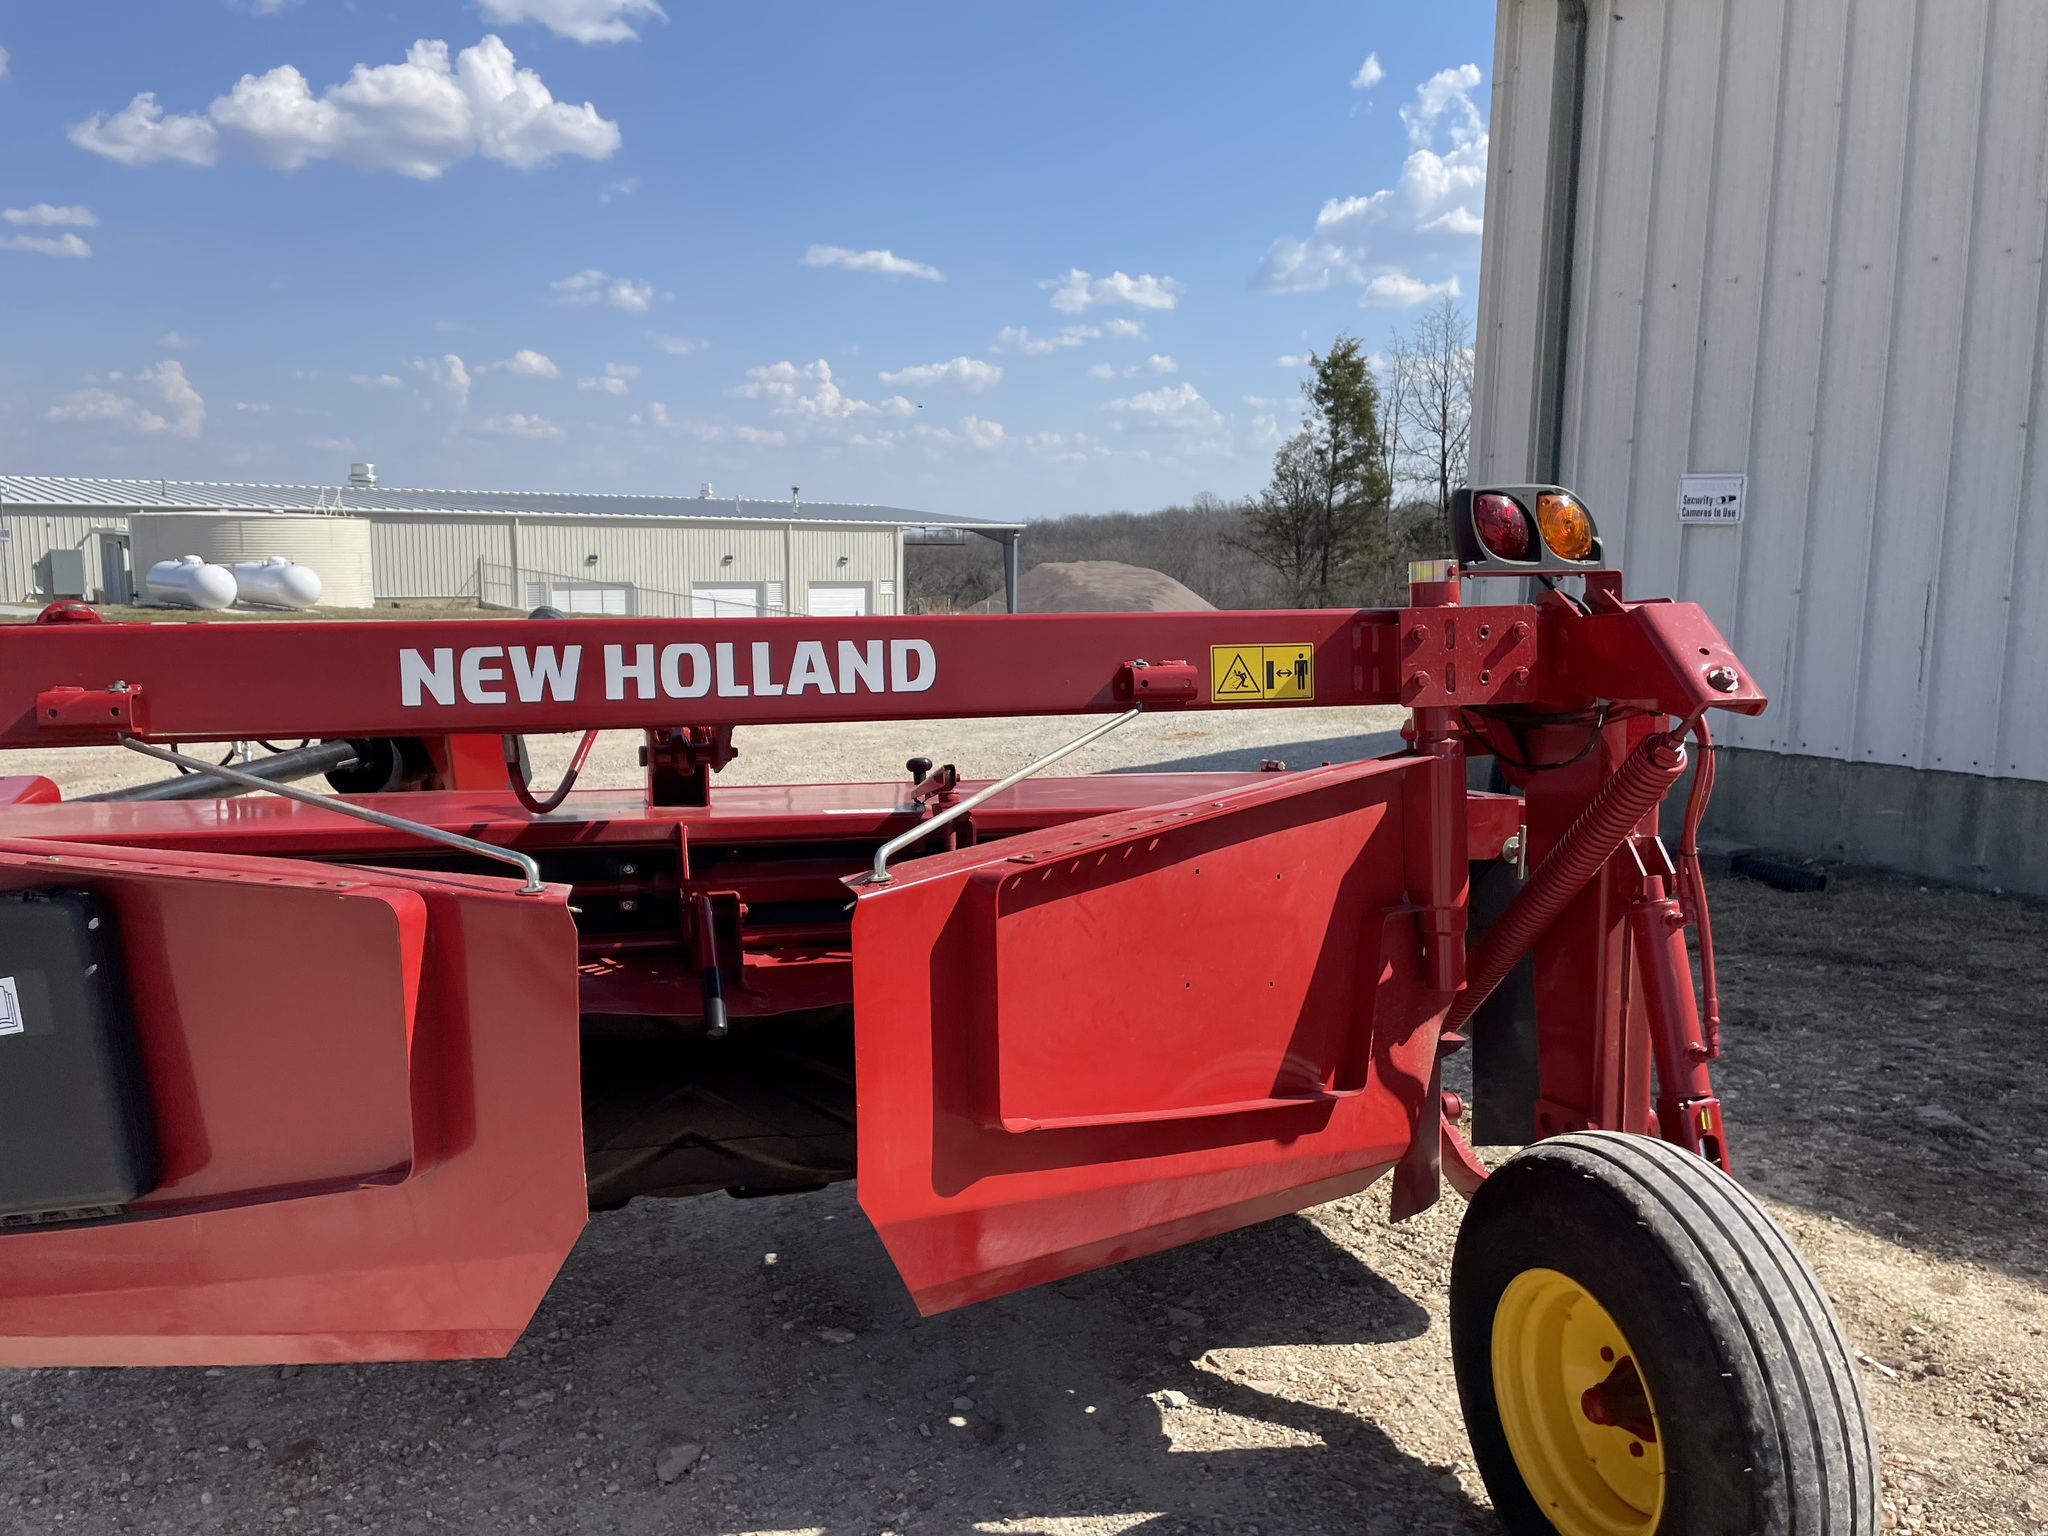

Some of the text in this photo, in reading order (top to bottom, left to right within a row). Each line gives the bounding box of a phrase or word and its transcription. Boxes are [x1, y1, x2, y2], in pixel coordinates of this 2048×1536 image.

[1683, 495, 1714, 506] Security
[1682, 507, 1736, 517] Cameras In Use
[399, 639, 937, 706] NEW HOLLAND
